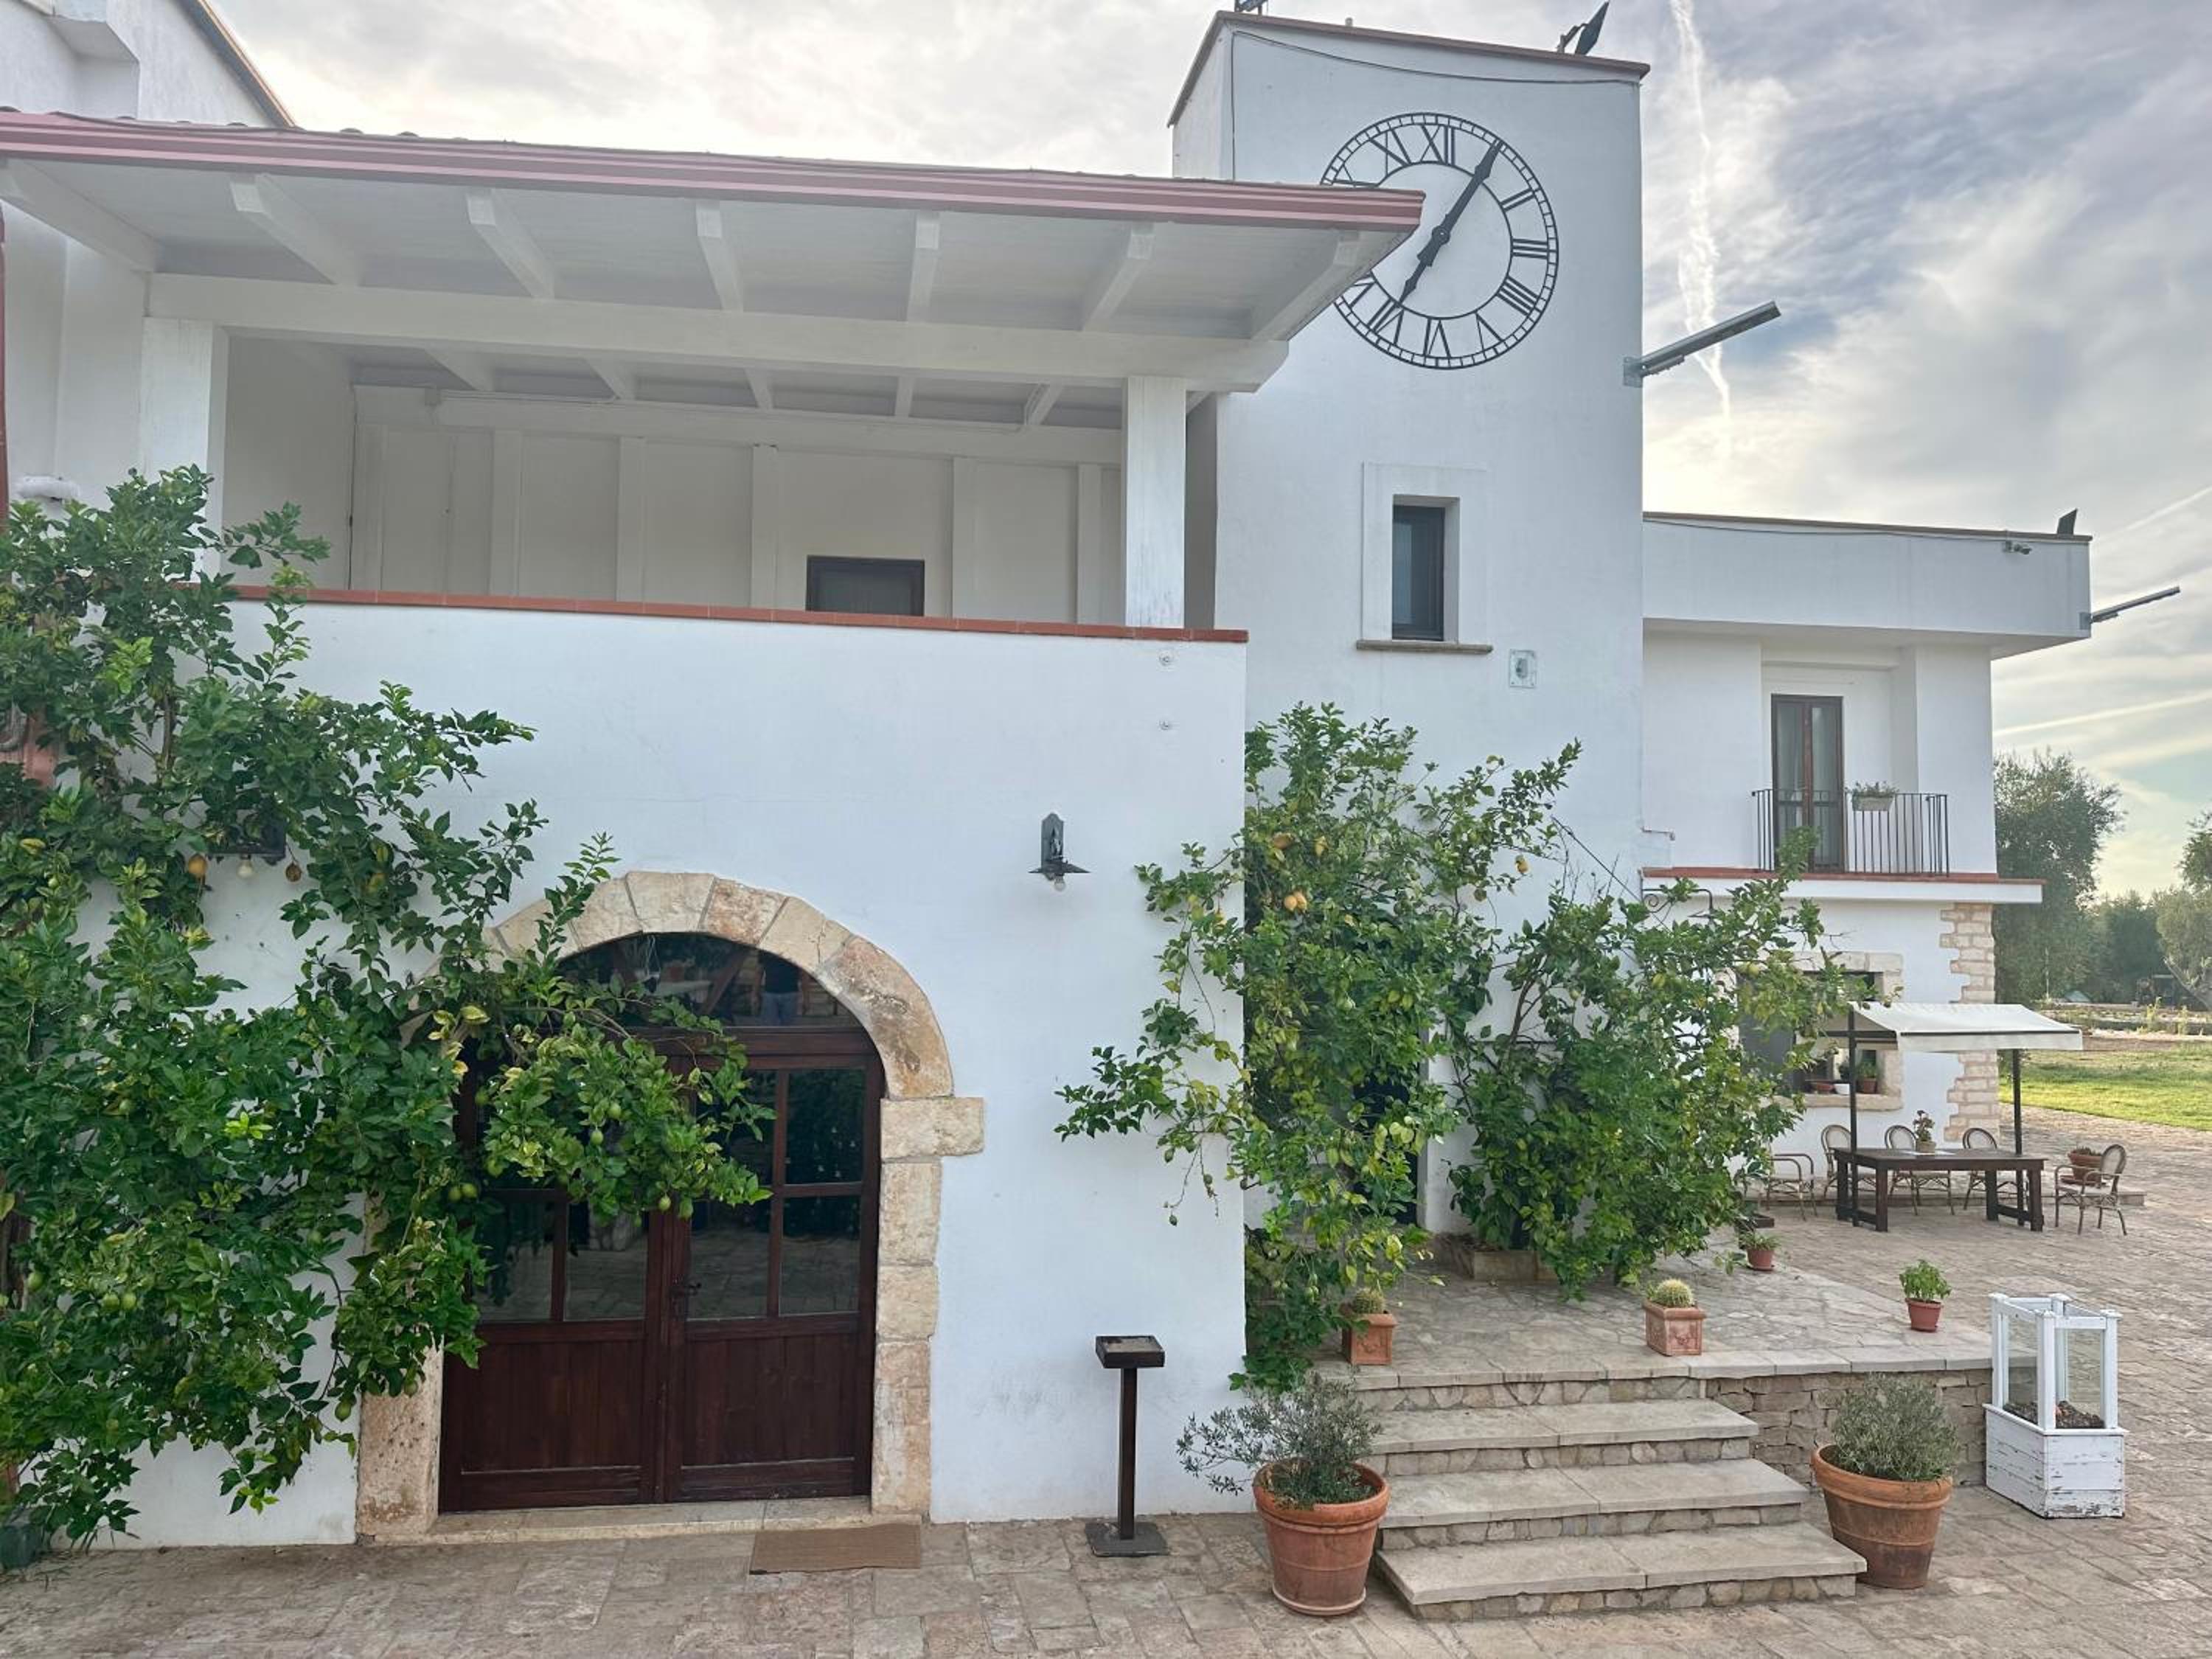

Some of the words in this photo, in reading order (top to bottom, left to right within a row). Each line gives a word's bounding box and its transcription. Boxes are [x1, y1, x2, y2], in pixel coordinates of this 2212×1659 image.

[1368, 128, 1411, 175] XI
[1419, 124, 1455, 166] XII
[1498, 188, 1534, 212] II
[1512, 238, 1548, 260] III
[1495, 275, 1540, 316] IIII
[1366, 299, 1404, 345] VII
[1423, 319, 1451, 358] VI
[1475, 313, 1504, 351] V
